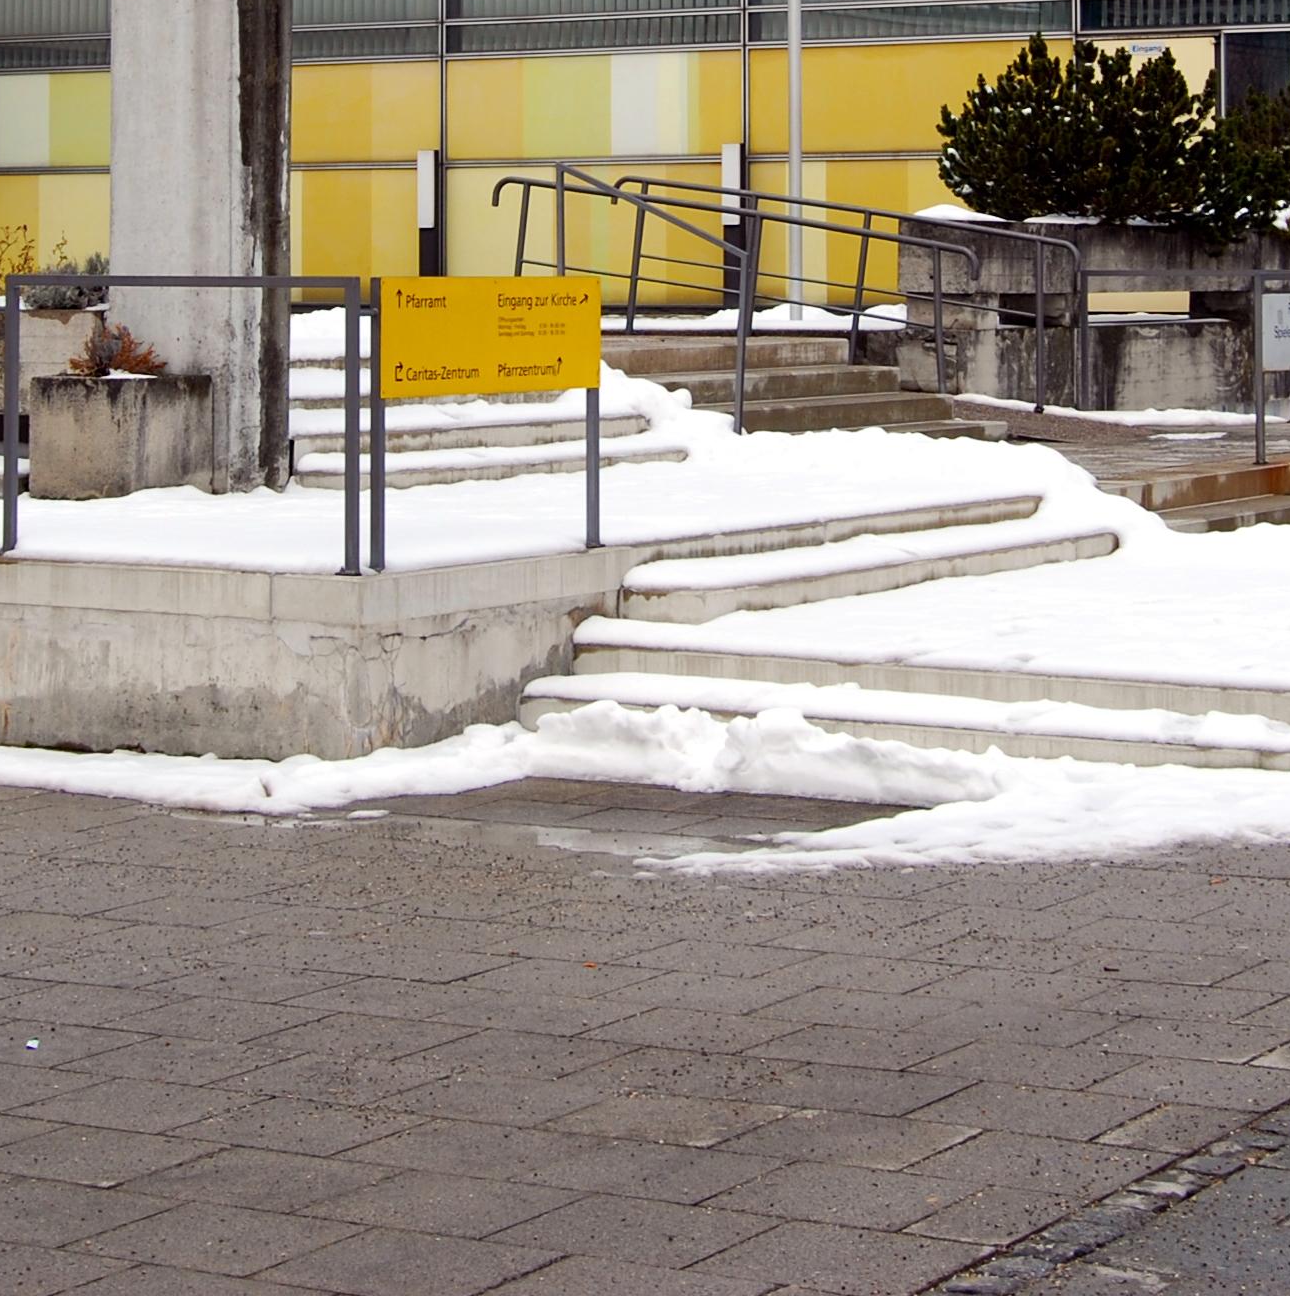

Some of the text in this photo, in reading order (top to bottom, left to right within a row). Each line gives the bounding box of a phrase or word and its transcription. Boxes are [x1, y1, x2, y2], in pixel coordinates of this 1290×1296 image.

[406, 294, 447, 308] Pfarramt
[497, 292, 577, 310] Eingang zur Kirche
[406, 366, 480, 381] Caritas-Zentrum
[497, 362, 556, 376] Pfarrzentrum
